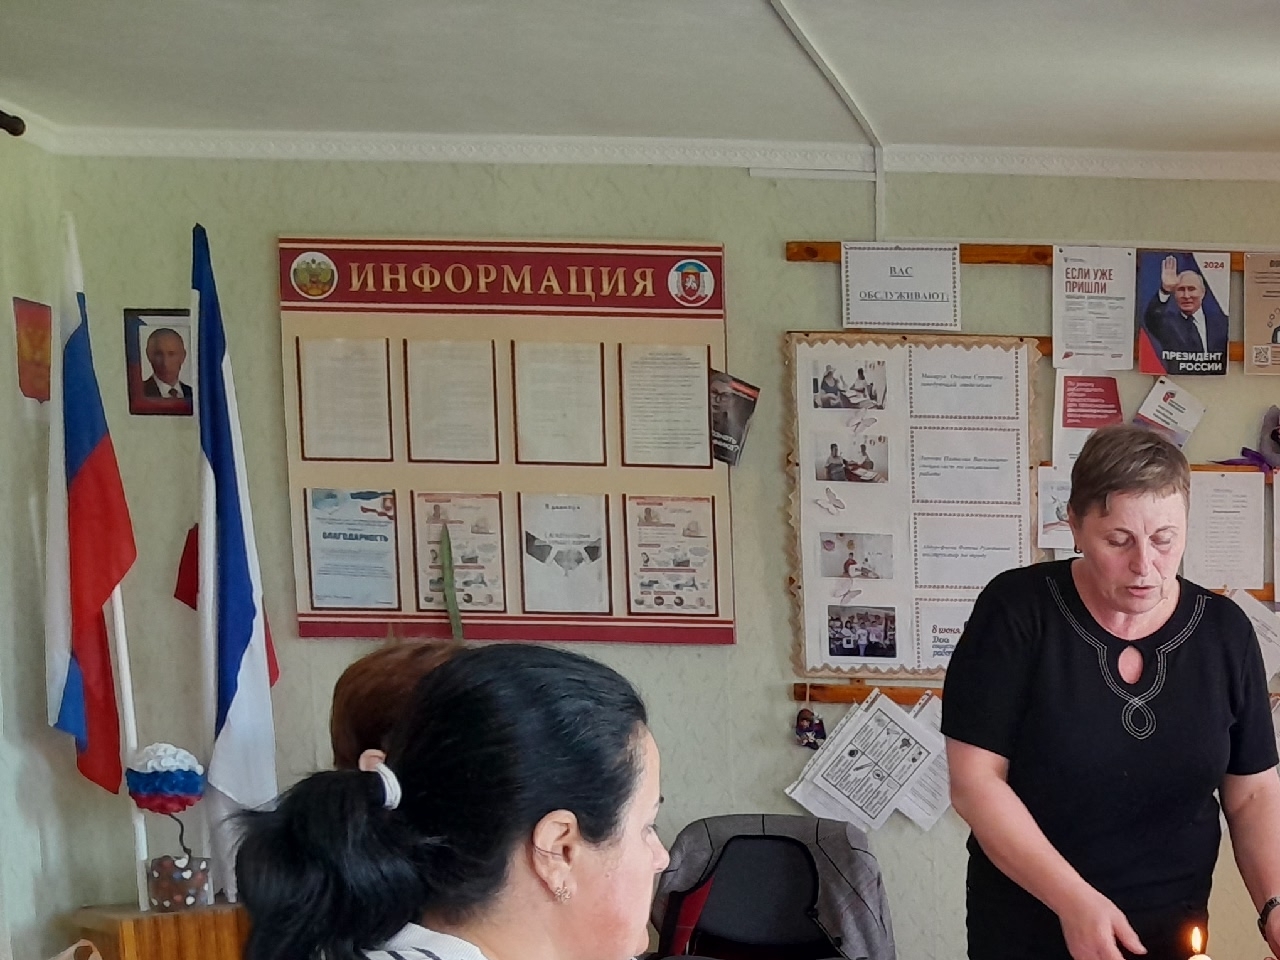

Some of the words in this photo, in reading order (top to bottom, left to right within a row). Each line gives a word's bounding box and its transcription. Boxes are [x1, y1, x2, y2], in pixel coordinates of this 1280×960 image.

[1203, 261, 1225, 270] 2024
[889, 266, 914, 278] ВАС
[1065, 267, 1091, 280] ЕСЛИ
[1092, 268, 1114, 281] УЖЕ
[349, 262, 656, 303] ИНФОРМАЦИЯ
[1065, 281, 1107, 294] ПРИШЛИ
[1162, 350, 1223, 362] ПРЕЗИДЕНТ
[1179, 362, 1222, 372] РОССИИ
[931, 624, 938, 634] 8
[938, 627, 962, 635] июня
